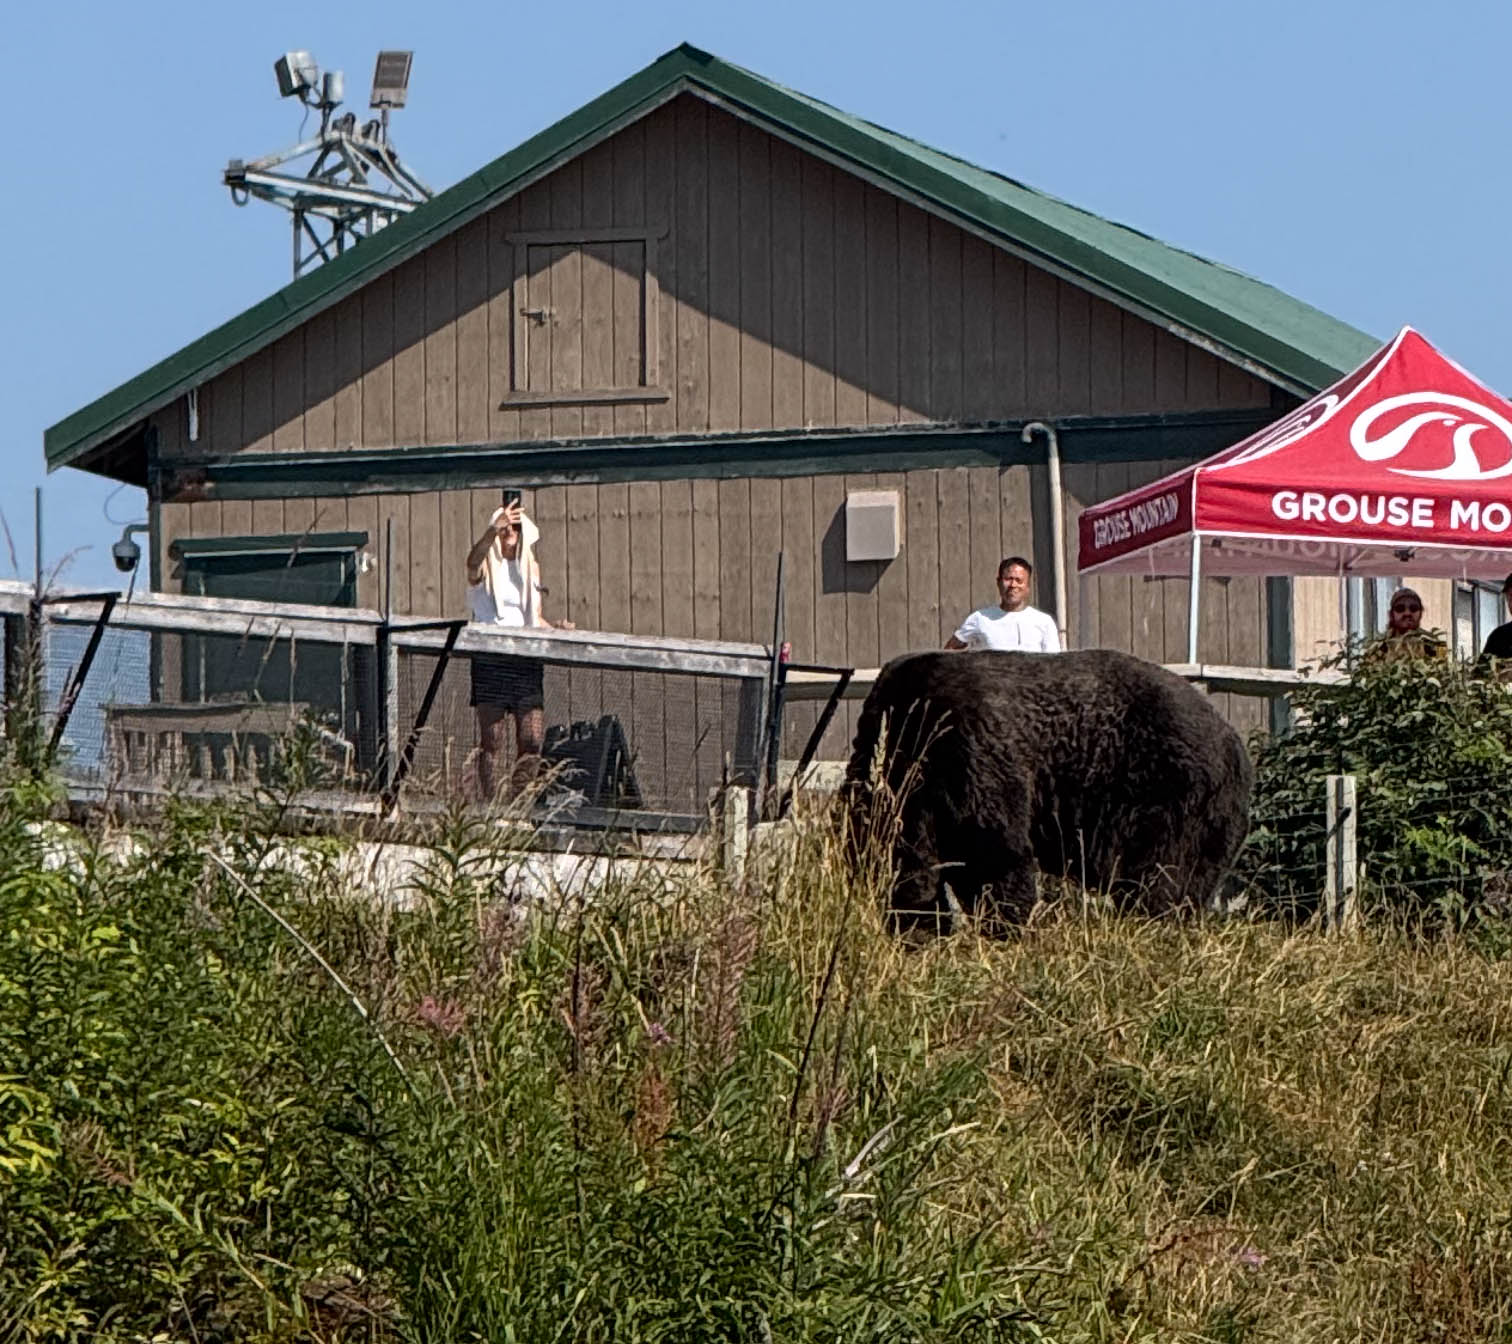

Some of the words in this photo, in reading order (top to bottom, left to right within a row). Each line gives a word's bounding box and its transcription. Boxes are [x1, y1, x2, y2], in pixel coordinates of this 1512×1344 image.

[1093, 510, 1132, 549] GROUSE
[1129, 492, 1179, 536] MOUNTAIN
[1272, 492, 1434, 528] GROUSE
